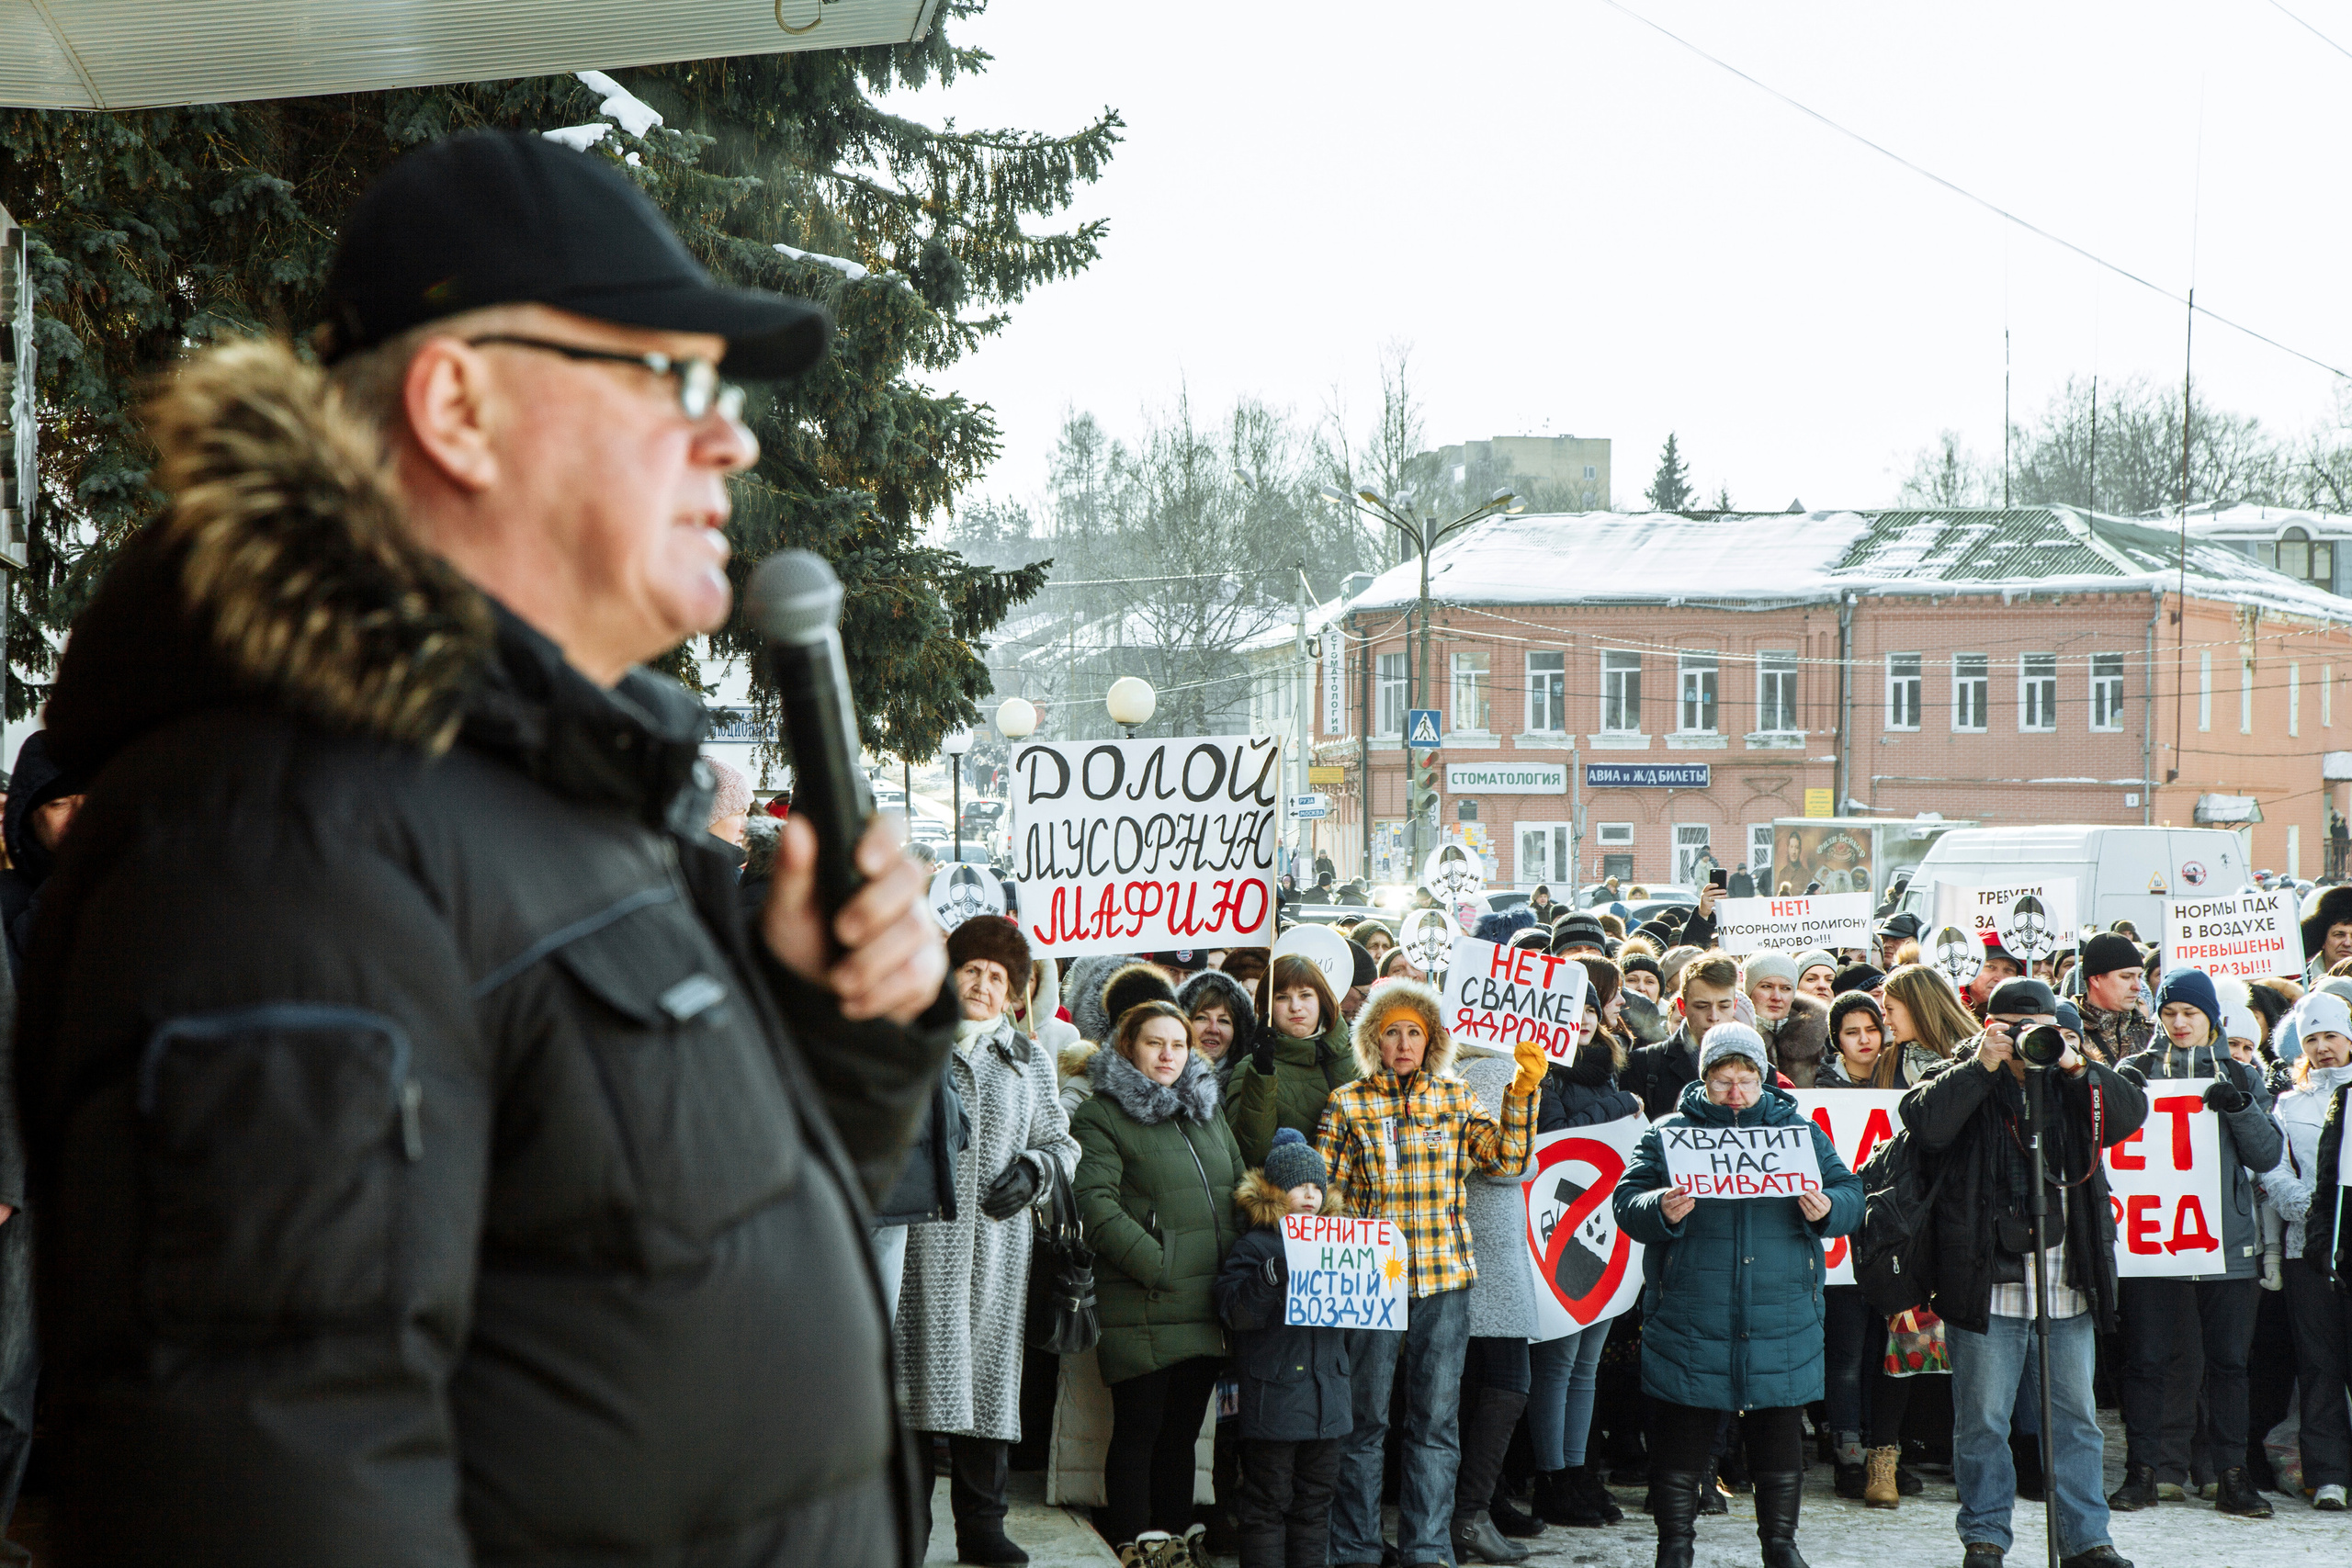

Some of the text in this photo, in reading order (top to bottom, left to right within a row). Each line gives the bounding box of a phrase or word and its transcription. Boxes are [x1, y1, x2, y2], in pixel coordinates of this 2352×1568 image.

[1016, 736, 1278, 807] ДОЛОЙ
[1452, 773, 1561, 785] СТОМАТОЛОГИЯ
[1589, 770, 1621, 782] АВИА
[1633, 770, 1657, 784] Ж/Д
[1658, 770, 1707, 782] БИЛЕТЫ
[1016, 809, 1275, 882] МУСОРНУЮ
[1034, 877, 1269, 945] МАФИЮ
[1770, 899, 1810, 917] НЕТ!
[2175, 897, 2279, 919] НОРМЫ ПДК
[1718, 919, 1868, 936] МУСОРНОМУ ПОЛИГОНУ
[2182, 918, 2276, 939] В ВОЗДУХЕ
[1757, 933, 1832, 949] «ЯДРОВО»!!!
[2177, 937, 2285, 959] ПРЕВЫШЕНЫ
[1490, 943, 1566, 989] НЕТ
[2210, 959, 2271, 977] РАЗЫ!!!
[1461, 976, 1573, 1024] СВАЛКЕ
[1667, 1127, 1808, 1149] ХВАТИТ
[1710, 1151, 1781, 1174] НАС
[1675, 1172, 1819, 1195] УБИВАТЬ
[1285, 1215, 1391, 1246] ВЕРНИТЕ
[1320, 1247, 1375, 1270] НАМ
[1288, 1297, 1396, 1328] ВОЗДУХ
